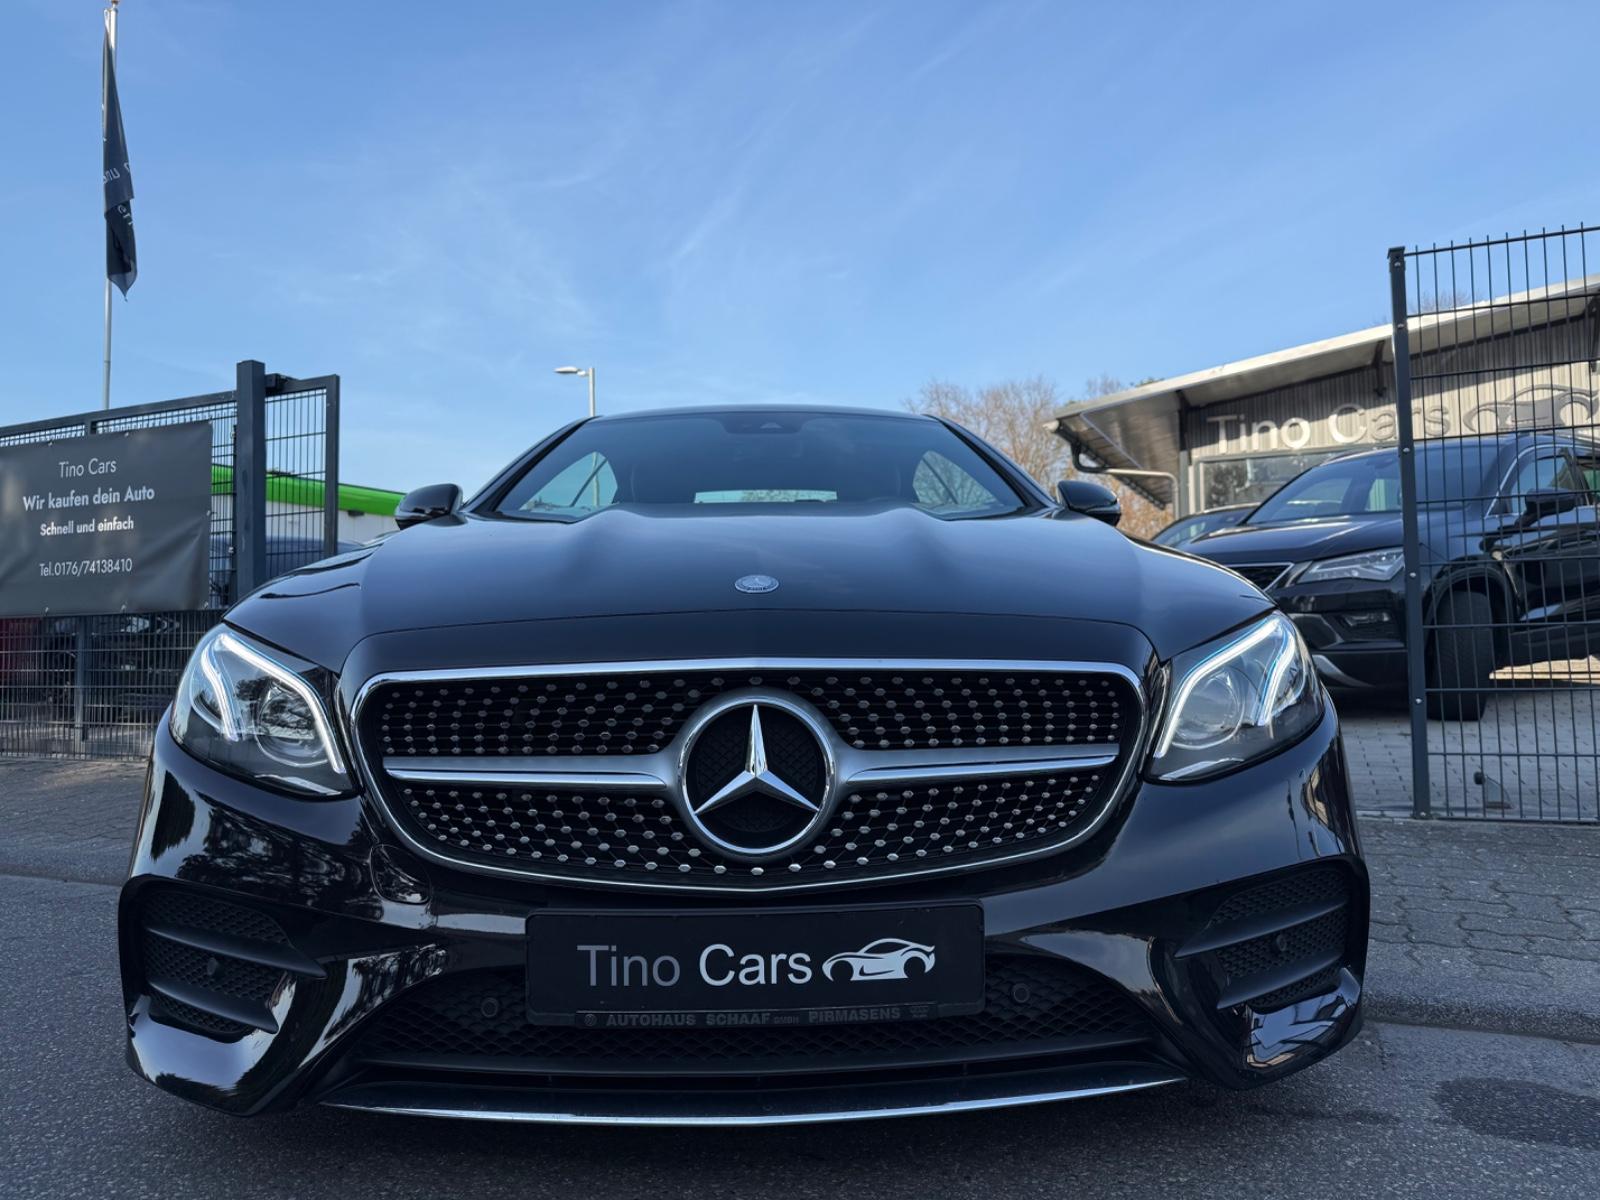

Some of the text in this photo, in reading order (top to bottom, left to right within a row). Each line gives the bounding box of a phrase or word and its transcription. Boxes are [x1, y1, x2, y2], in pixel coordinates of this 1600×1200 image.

[1207, 413, 1311, 454] Tino
[59, 457, 117, 478] Tino Cars
[22, 485, 155, 511] Wir kaufen dein Auto
[40, 515, 134, 536] Schnell und einfach
[577, 943, 813, 986] Tino Cars
[606, 1013, 697, 1027] AUTOHAUS
[705, 1012, 771, 1026] SCHAAF
